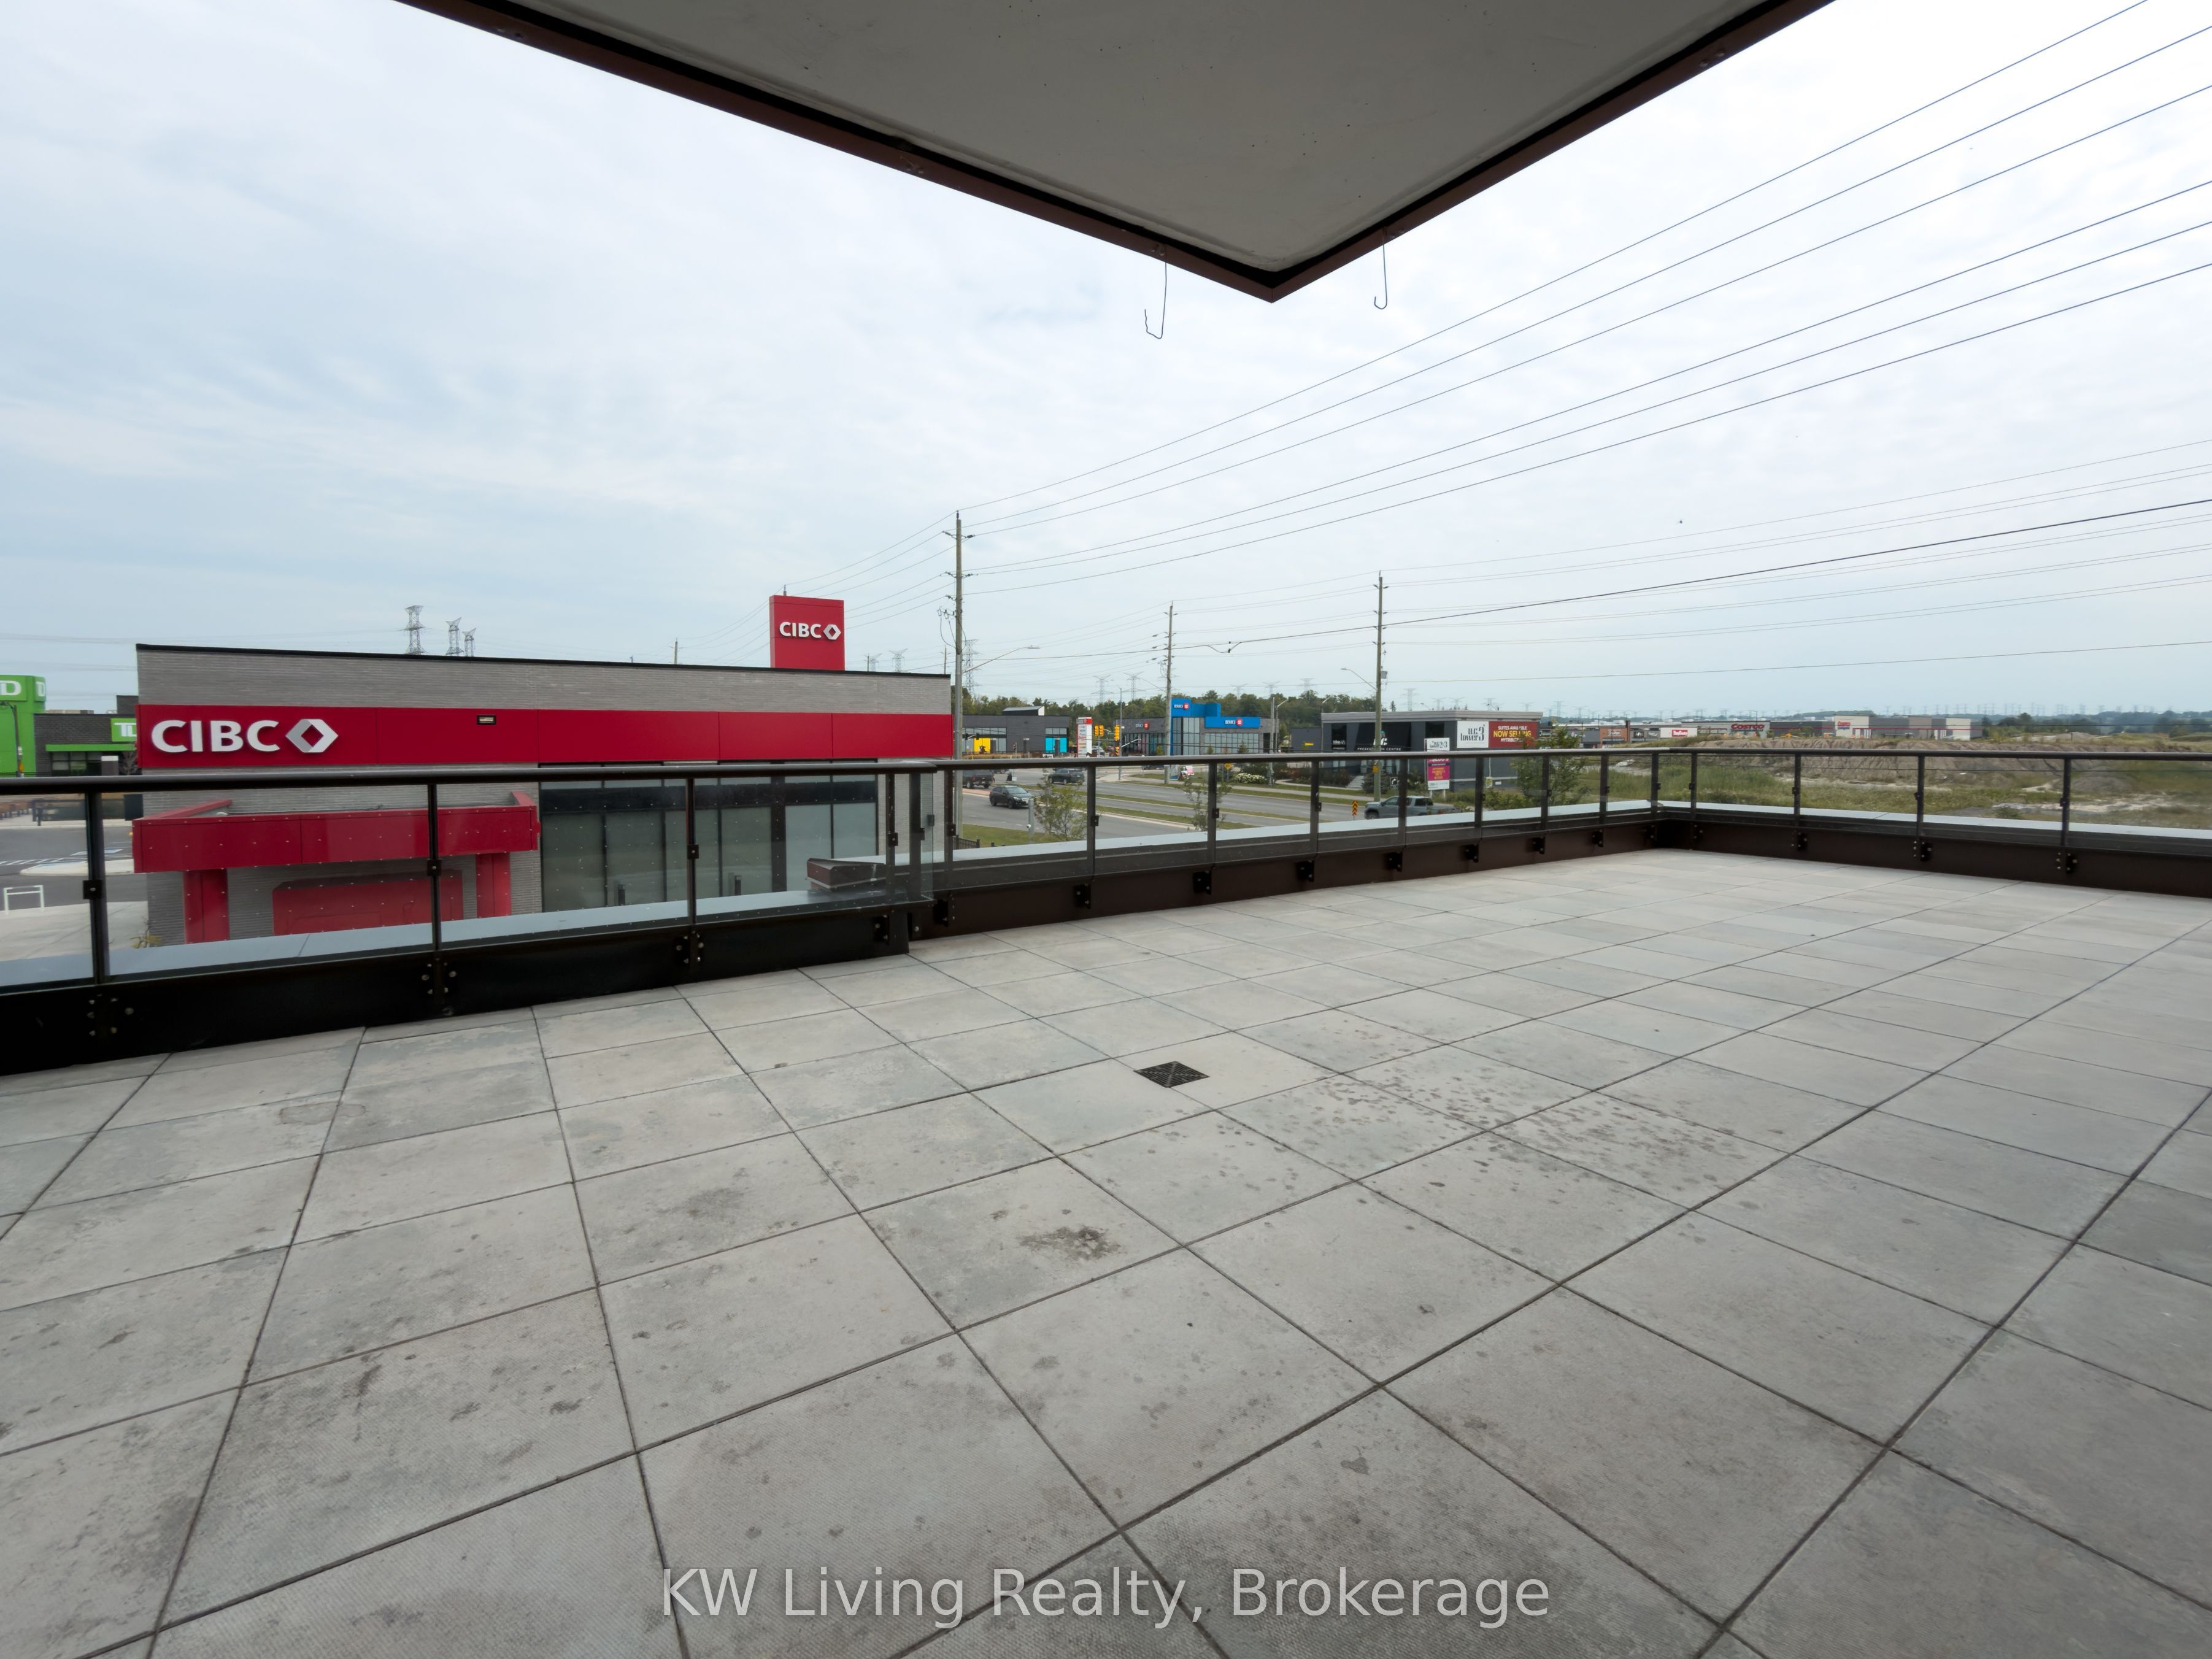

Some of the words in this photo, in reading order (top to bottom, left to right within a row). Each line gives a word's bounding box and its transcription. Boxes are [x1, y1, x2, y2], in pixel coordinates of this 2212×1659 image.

[779, 622, 822, 639] CIBC
[0, 680, 21, 696] D
[152, 720, 280, 753] CIBC
[1479, 726, 1484, 741] 3
